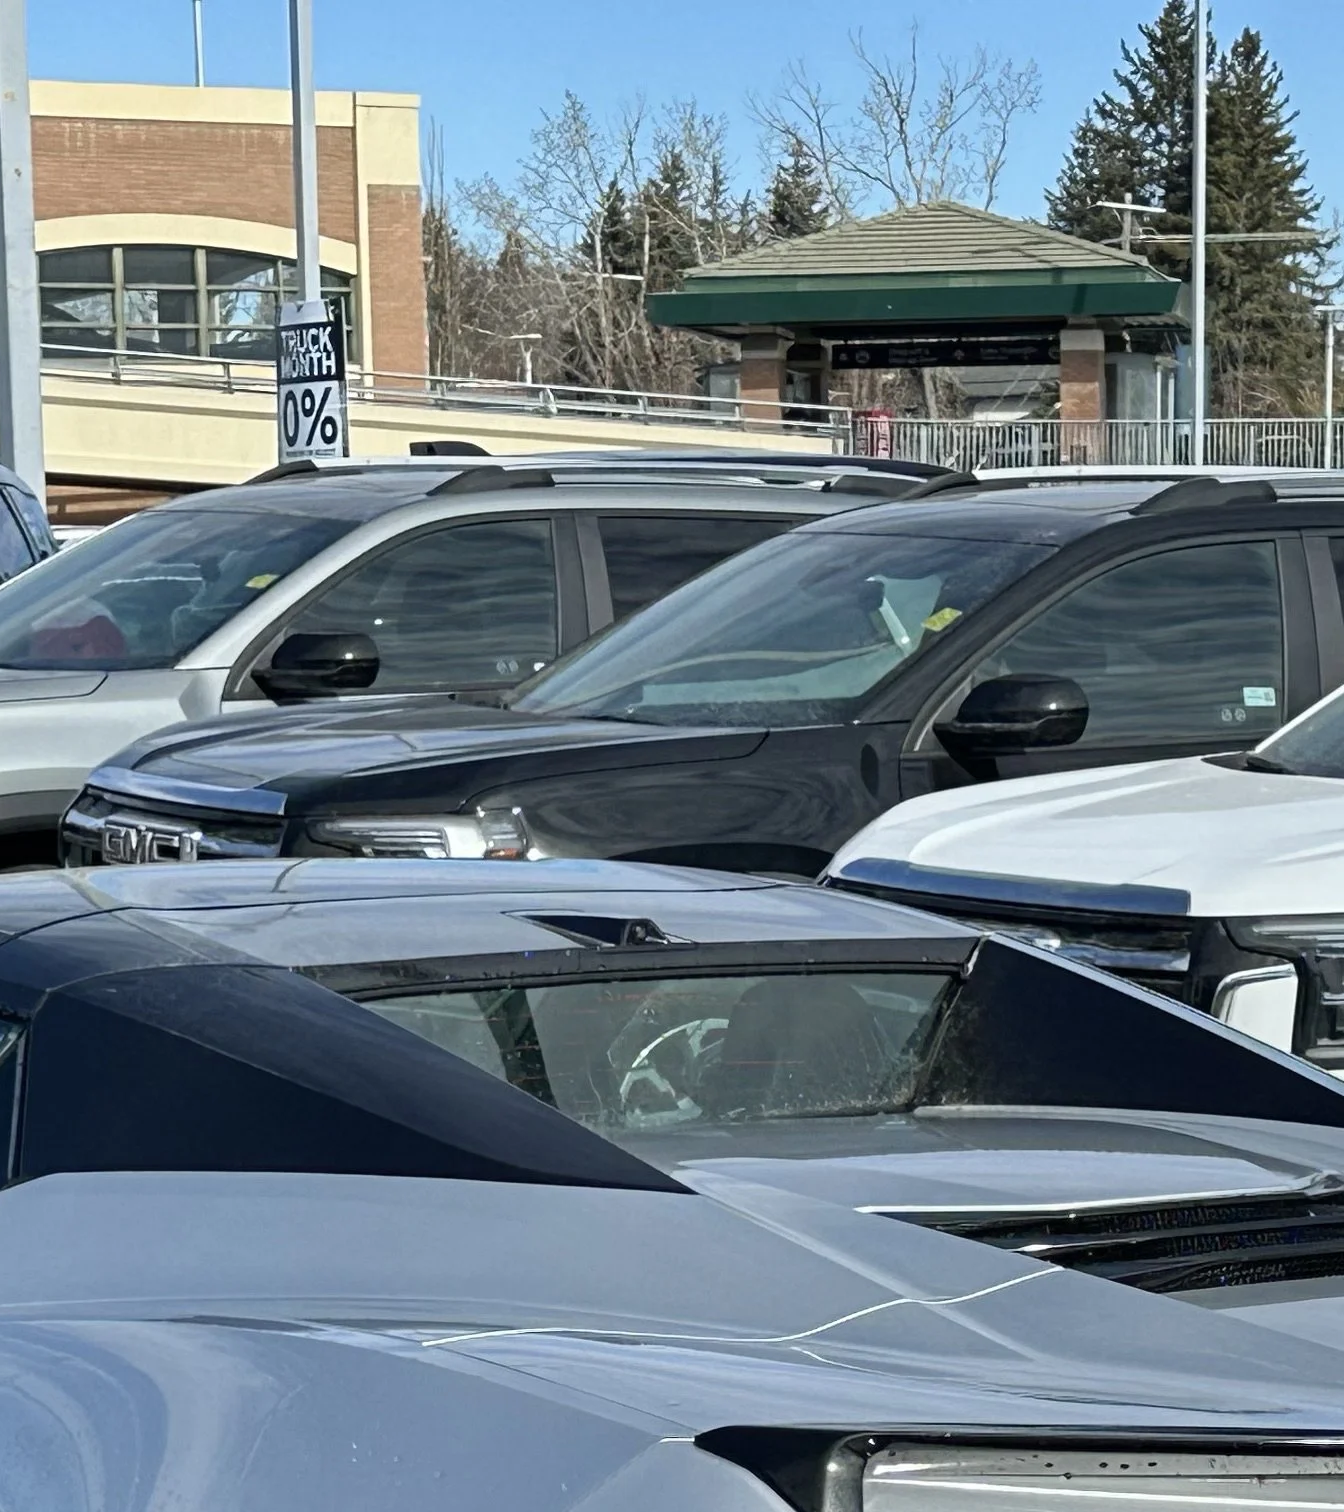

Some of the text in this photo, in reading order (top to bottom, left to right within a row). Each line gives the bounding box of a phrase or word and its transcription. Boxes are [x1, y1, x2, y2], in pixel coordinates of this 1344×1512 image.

[281, 326, 334, 353] TRUCK
[281, 350, 337, 379] MONTH
[283, 386, 339, 448] 0%
[103, 823, 197, 866] GMC
